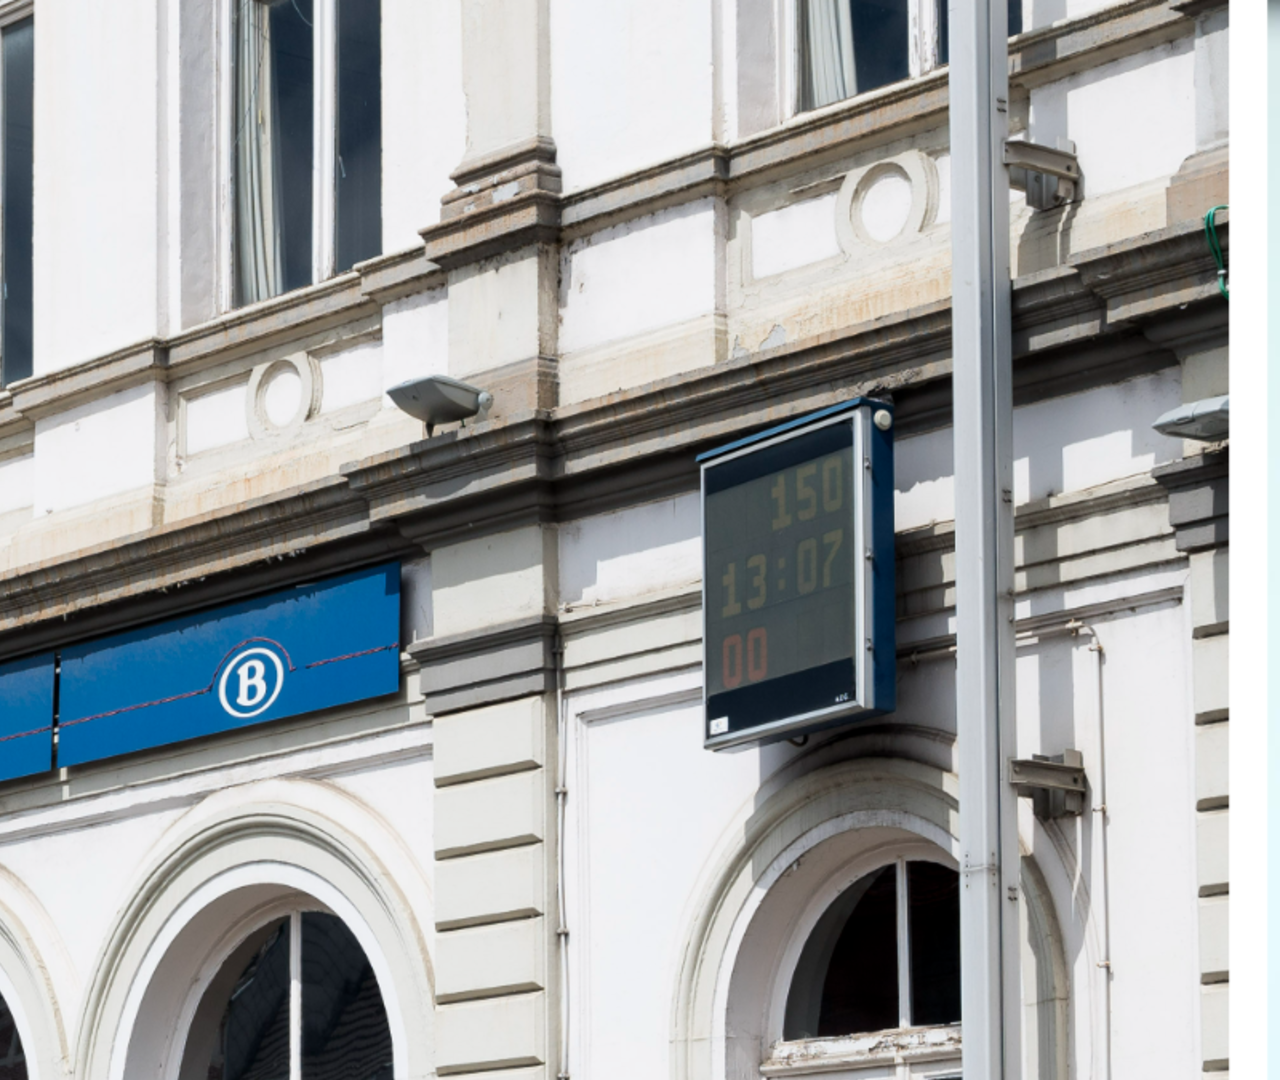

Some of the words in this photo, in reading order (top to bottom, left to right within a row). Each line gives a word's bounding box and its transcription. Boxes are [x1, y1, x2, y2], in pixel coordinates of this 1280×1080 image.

[771, 455, 842, 531] 150
[722, 528, 844, 618] 13:07
[236, 659, 267, 706] B
[722, 626, 768, 689] 00
